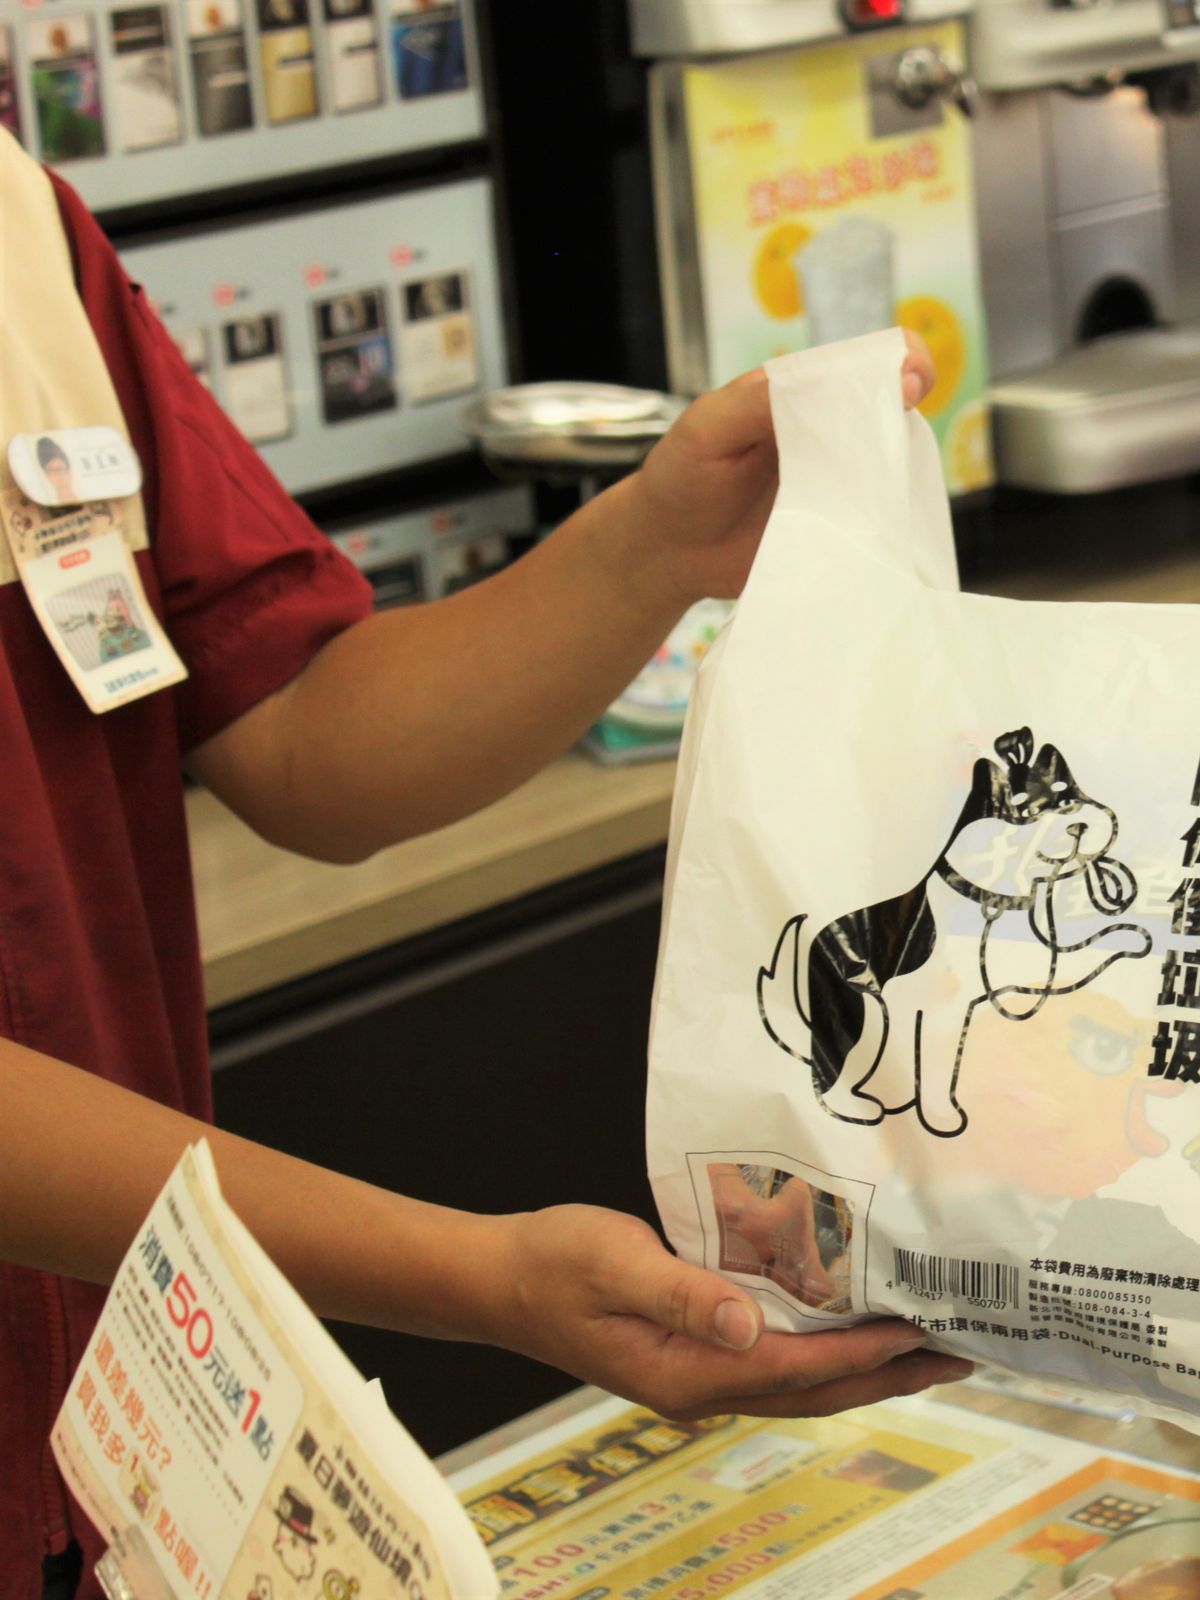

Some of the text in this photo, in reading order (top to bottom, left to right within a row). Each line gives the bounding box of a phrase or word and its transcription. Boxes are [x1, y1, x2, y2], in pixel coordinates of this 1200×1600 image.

[908, 1284, 944, 1301] 712417
[967, 1297, 1007, 1310] 550707
[1029, 1279, 1152, 1304] 服務專線:0800085350
[139, 1226, 274, 1461] 消費50元送1點
[902, 1314, 1171, 1372] 北市環保兩用袋-Dual-Purpose
